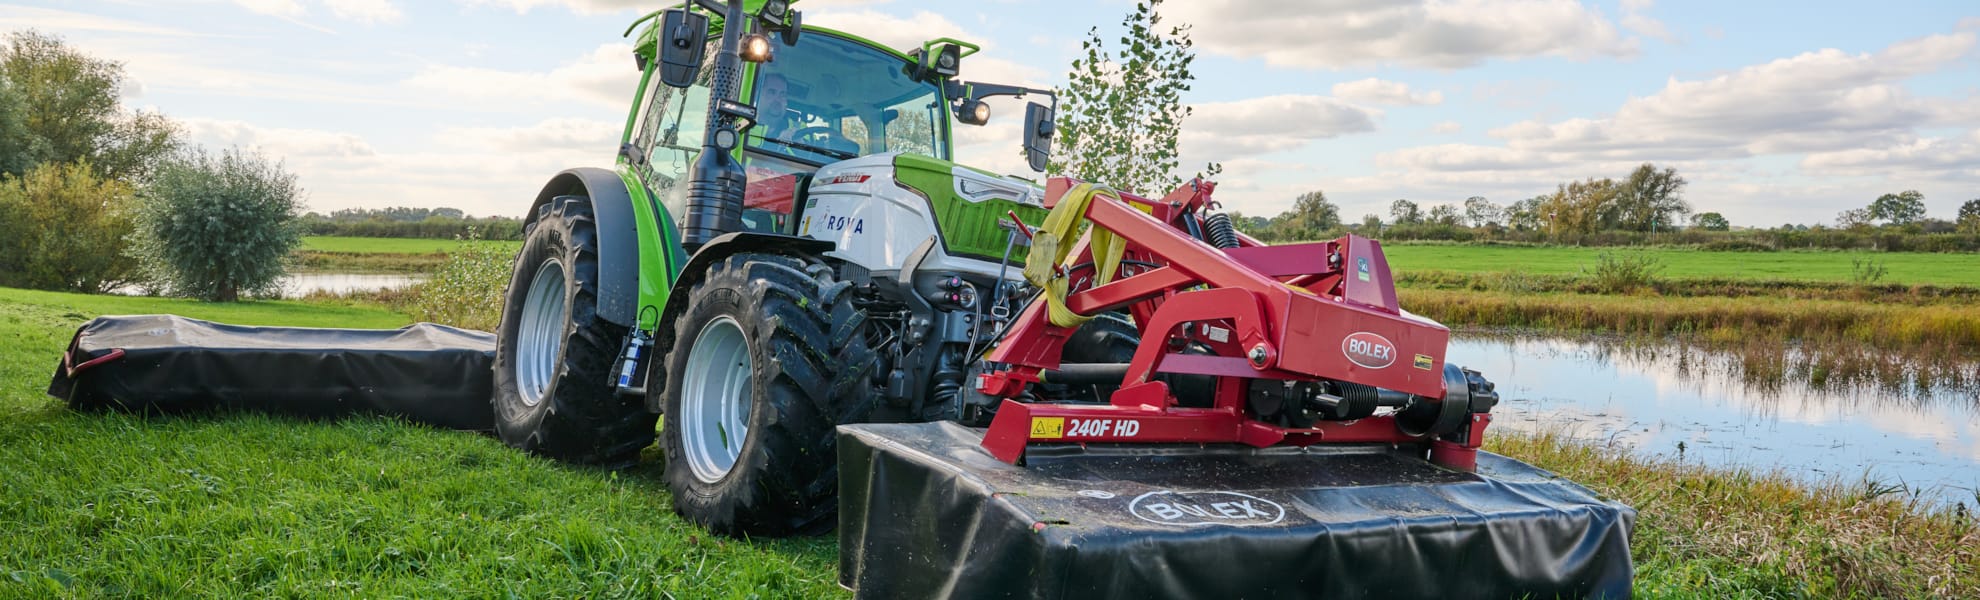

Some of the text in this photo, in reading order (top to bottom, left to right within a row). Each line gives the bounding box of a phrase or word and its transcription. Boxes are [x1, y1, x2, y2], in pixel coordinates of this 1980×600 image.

[1349, 338, 1391, 361] BOLEX
[1066, 418, 1140, 437] 240F HD
[1145, 499, 1271, 521] BOLEX
